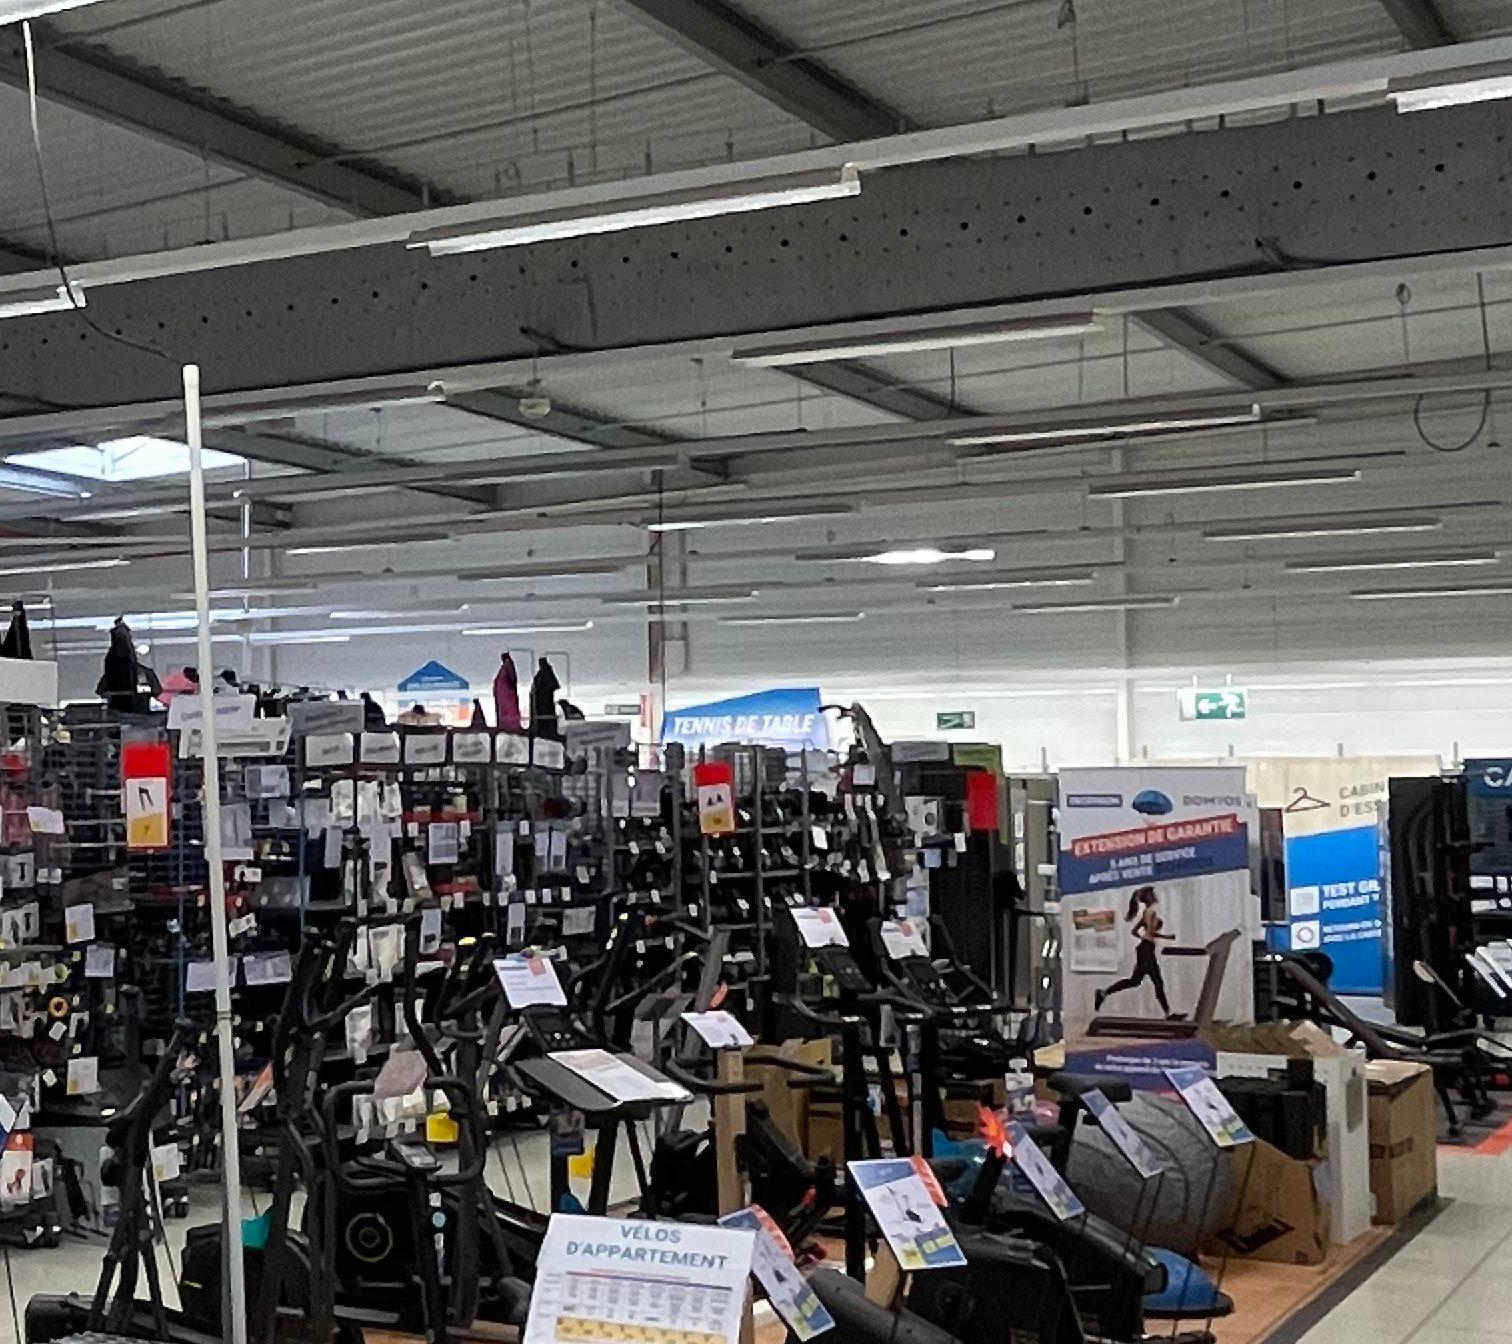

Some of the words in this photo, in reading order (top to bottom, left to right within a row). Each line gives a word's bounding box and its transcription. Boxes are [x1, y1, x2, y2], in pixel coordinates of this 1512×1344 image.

[674, 715, 733, 734] TENNIS
[736, 715, 759, 733] DE
[763, 714, 815, 733] TABLE
[1322, 882, 1356, 898] TEST
[620, 1223, 682, 1244] VÉLOS
[566, 1241, 728, 1270] D'APPARTEMENT
